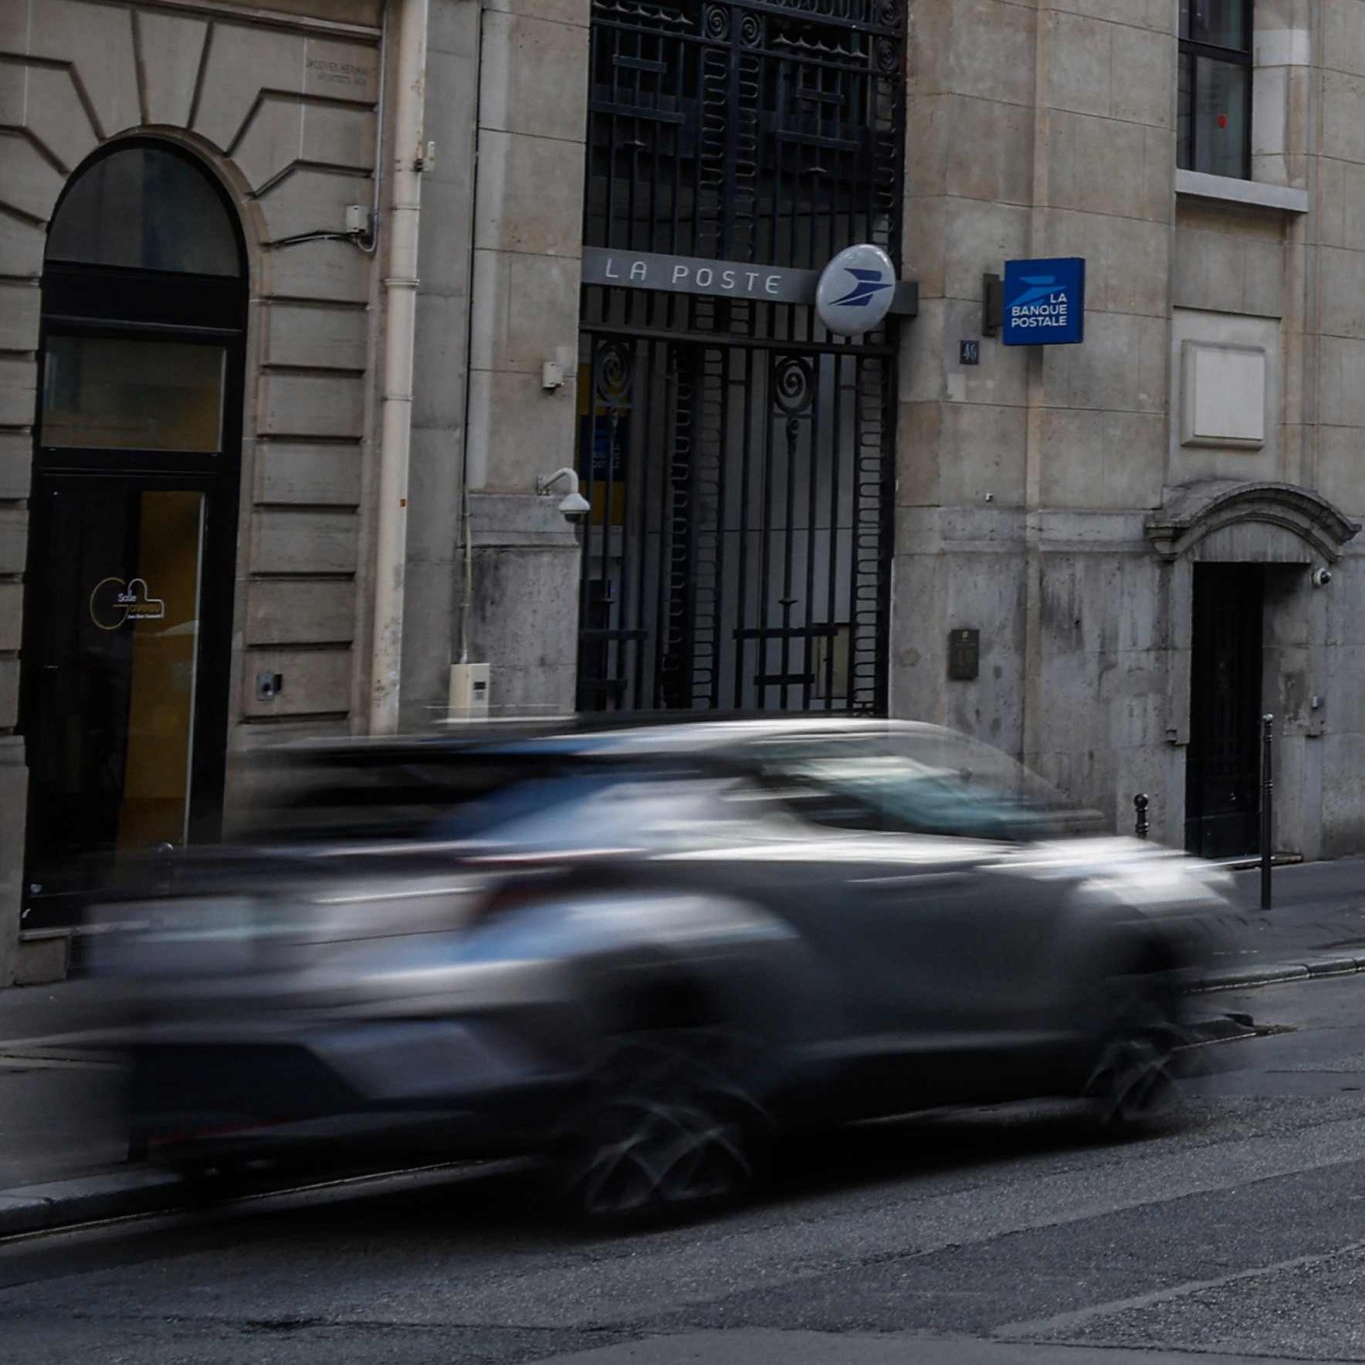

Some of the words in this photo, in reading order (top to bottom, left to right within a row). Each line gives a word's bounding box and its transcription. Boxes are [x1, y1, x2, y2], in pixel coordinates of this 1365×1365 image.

[606, 258, 647, 281] LA
[672, 265, 782, 294] POSTE
[1050, 293, 1067, 303] LA
[1012, 304, 1067, 316] BANQUE
[1011, 316, 1067, 327] POSTALE
